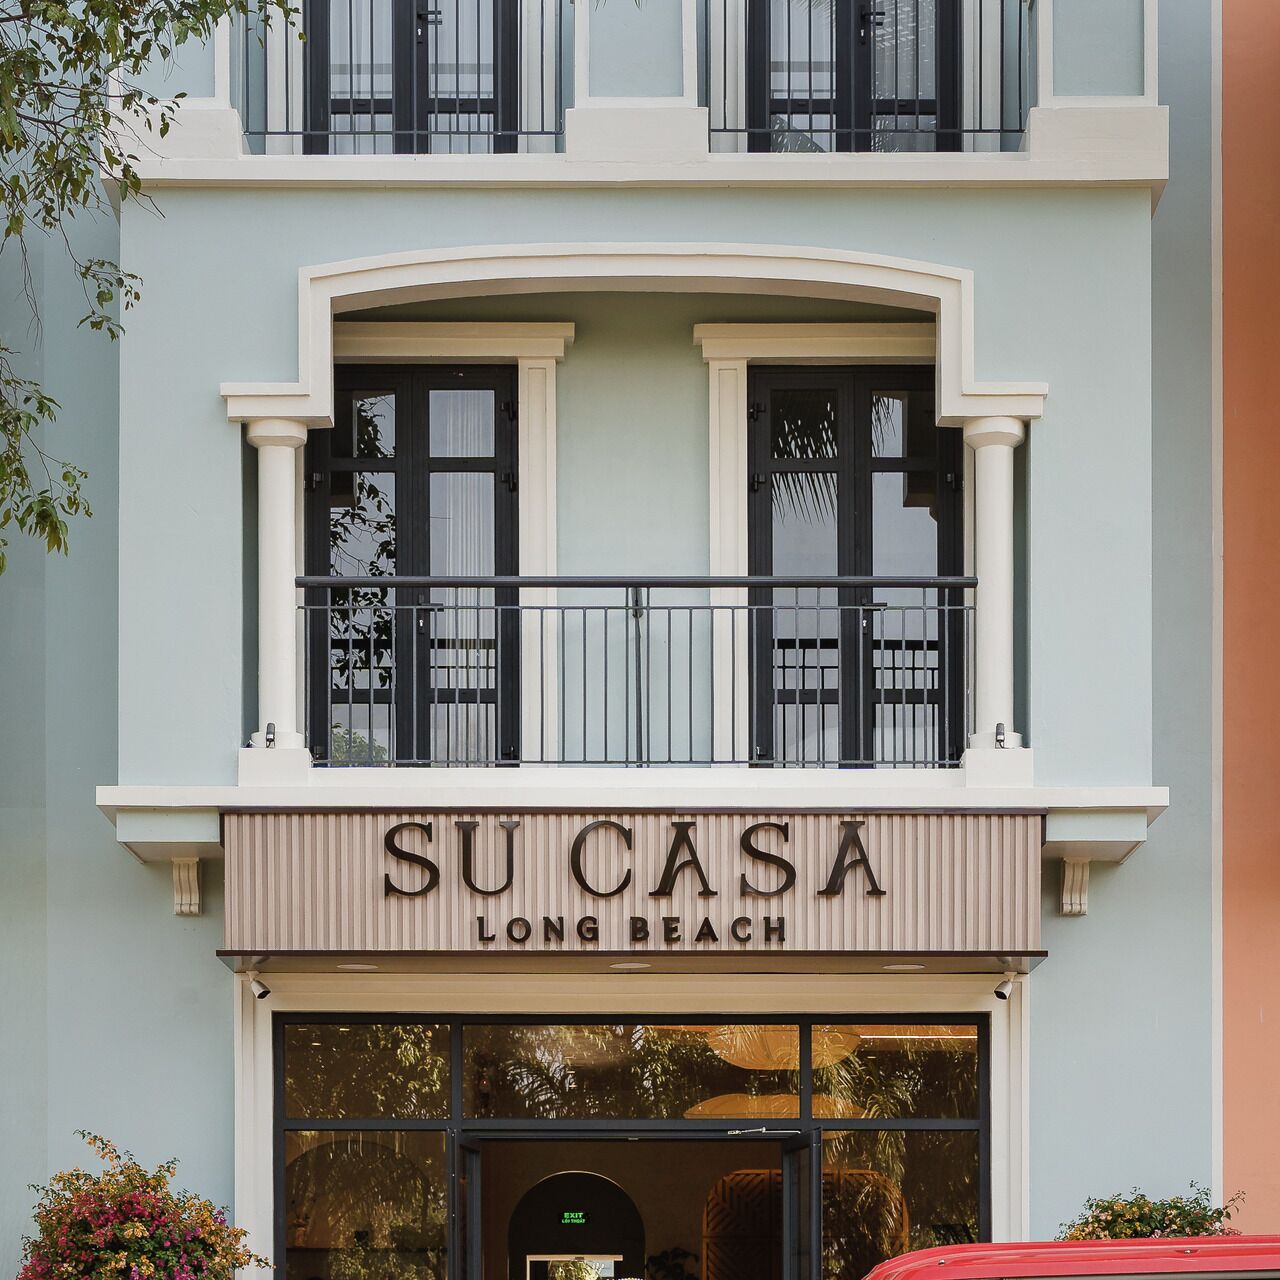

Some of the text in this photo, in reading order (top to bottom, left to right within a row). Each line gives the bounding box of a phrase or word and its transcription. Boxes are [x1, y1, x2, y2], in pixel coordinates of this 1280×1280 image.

[383, 819, 887, 900] SU CASA
[476, 915, 787, 944] LONG BEACH
